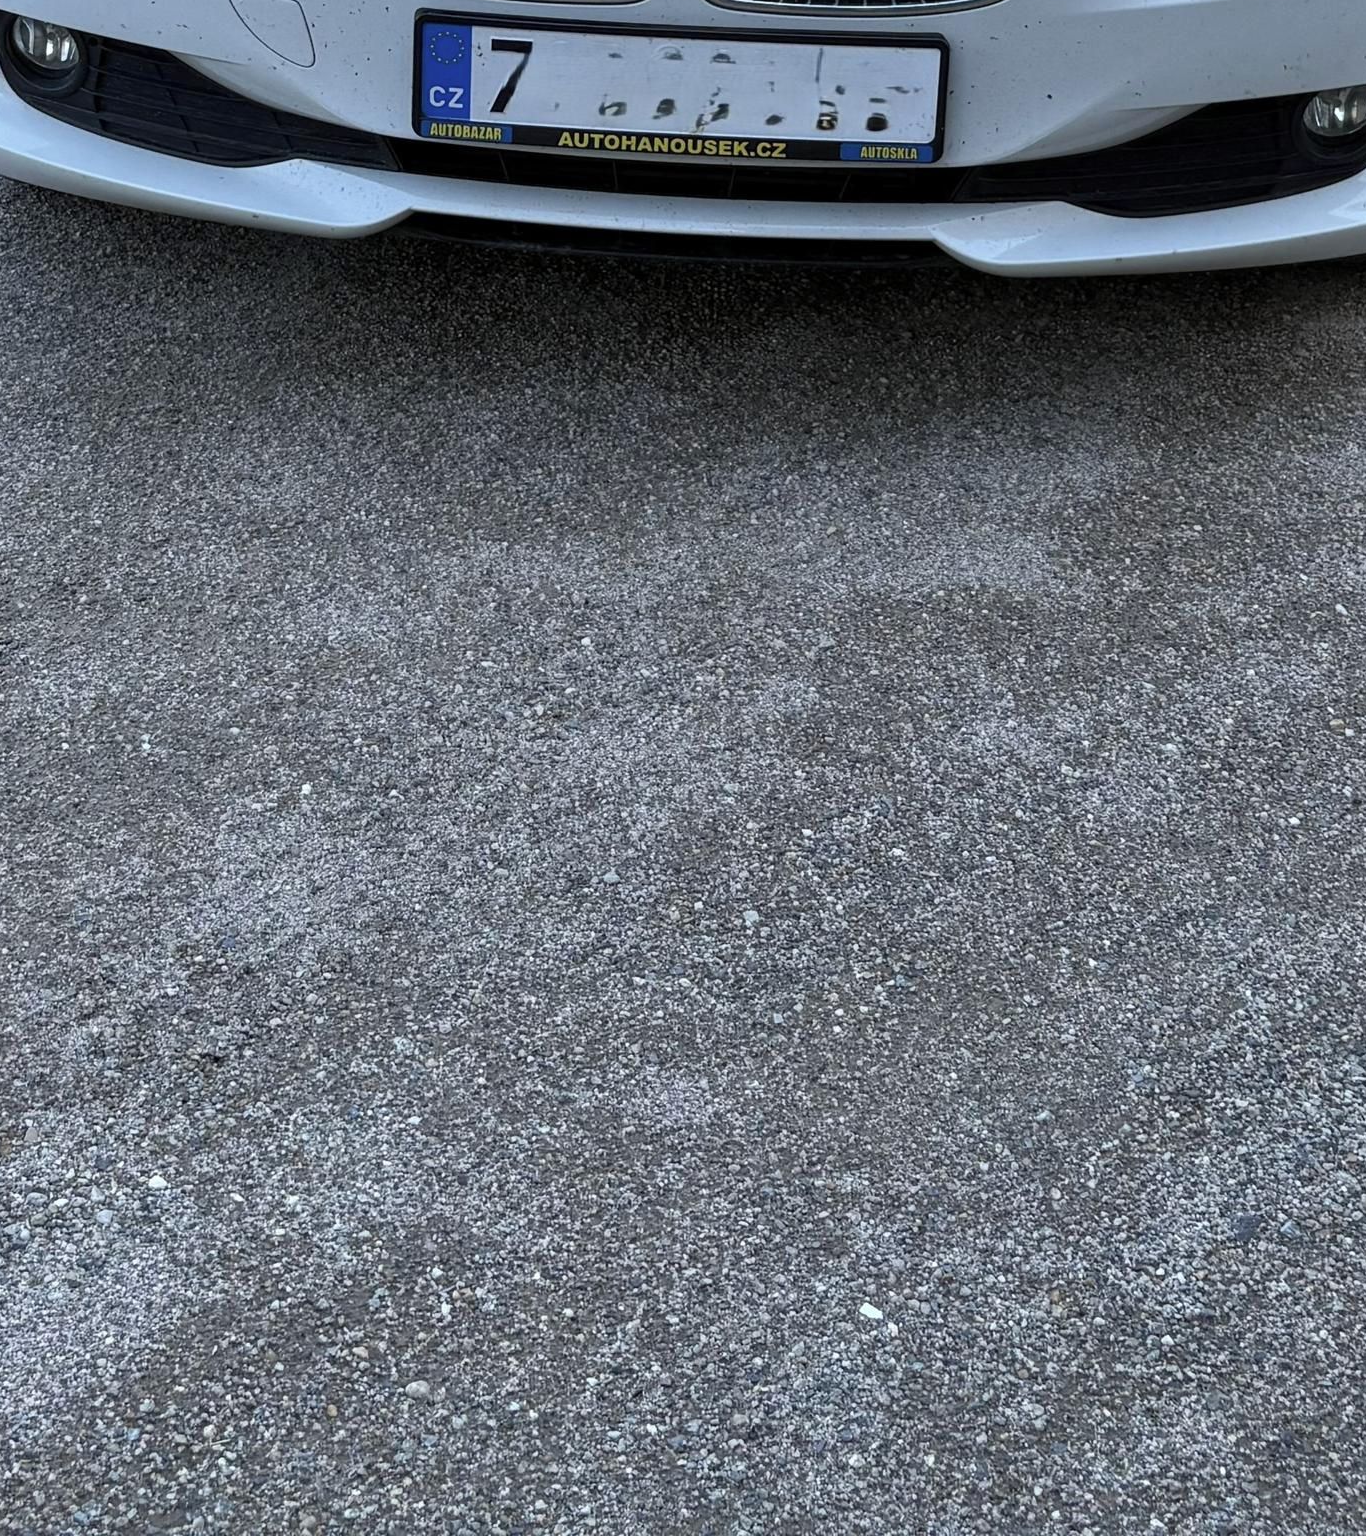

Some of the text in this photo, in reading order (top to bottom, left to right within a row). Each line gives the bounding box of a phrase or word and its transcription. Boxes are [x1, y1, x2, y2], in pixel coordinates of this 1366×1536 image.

[429, 85, 464, 109] CZ
[430, 122, 503, 141] AUTOBAZAR
[558, 131, 787, 158] AUTOHANOUSEK.CZ
[860, 146, 918, 160] AUTOSKLA
